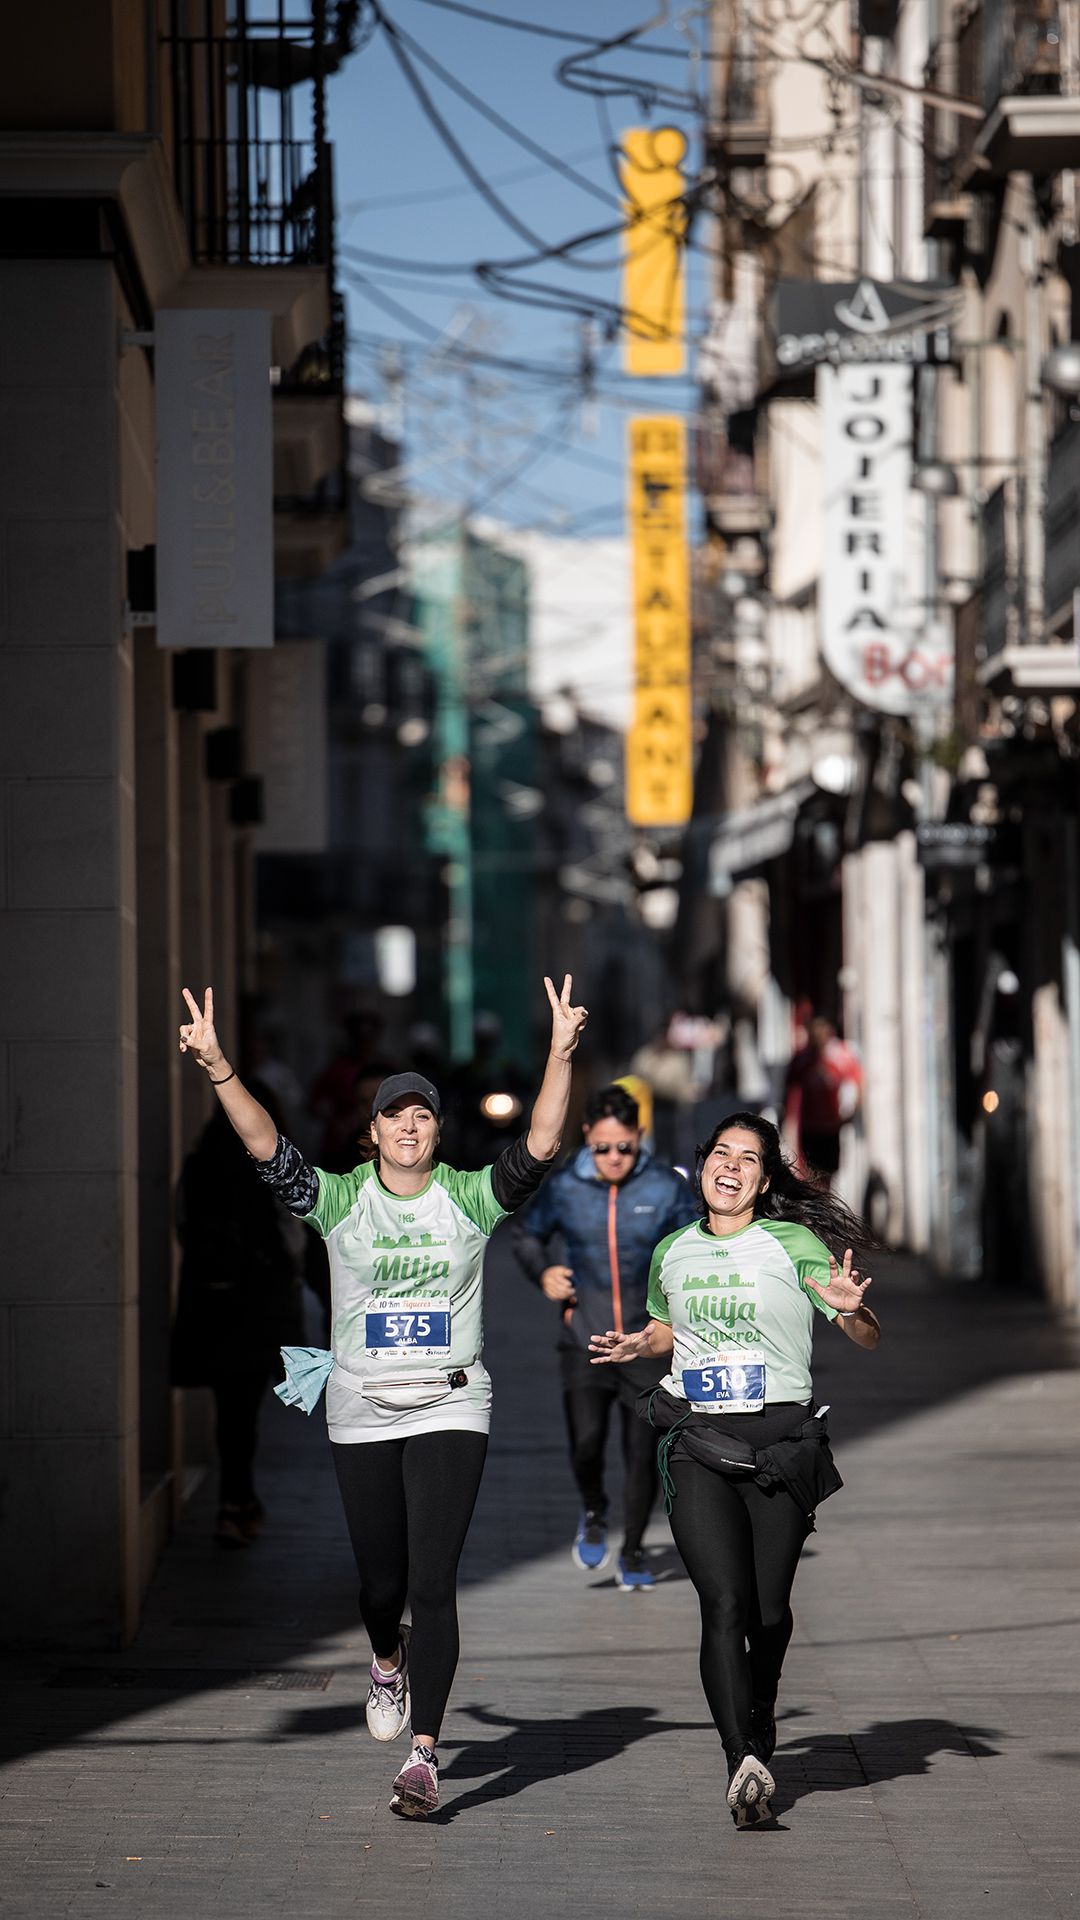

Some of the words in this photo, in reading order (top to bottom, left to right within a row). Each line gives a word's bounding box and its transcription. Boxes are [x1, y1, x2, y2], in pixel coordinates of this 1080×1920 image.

[844, 375, 886, 630] JOIERIA
[371, 1254, 450, 1287] Mitja
[685, 1294, 757, 1327] Mitja
[385, 1315, 431, 1338] 575
[397, 1337, 418, 1345] ALBA
[701, 1367, 747, 1392] 510
[715, 1391, 731, 1399] EVA
